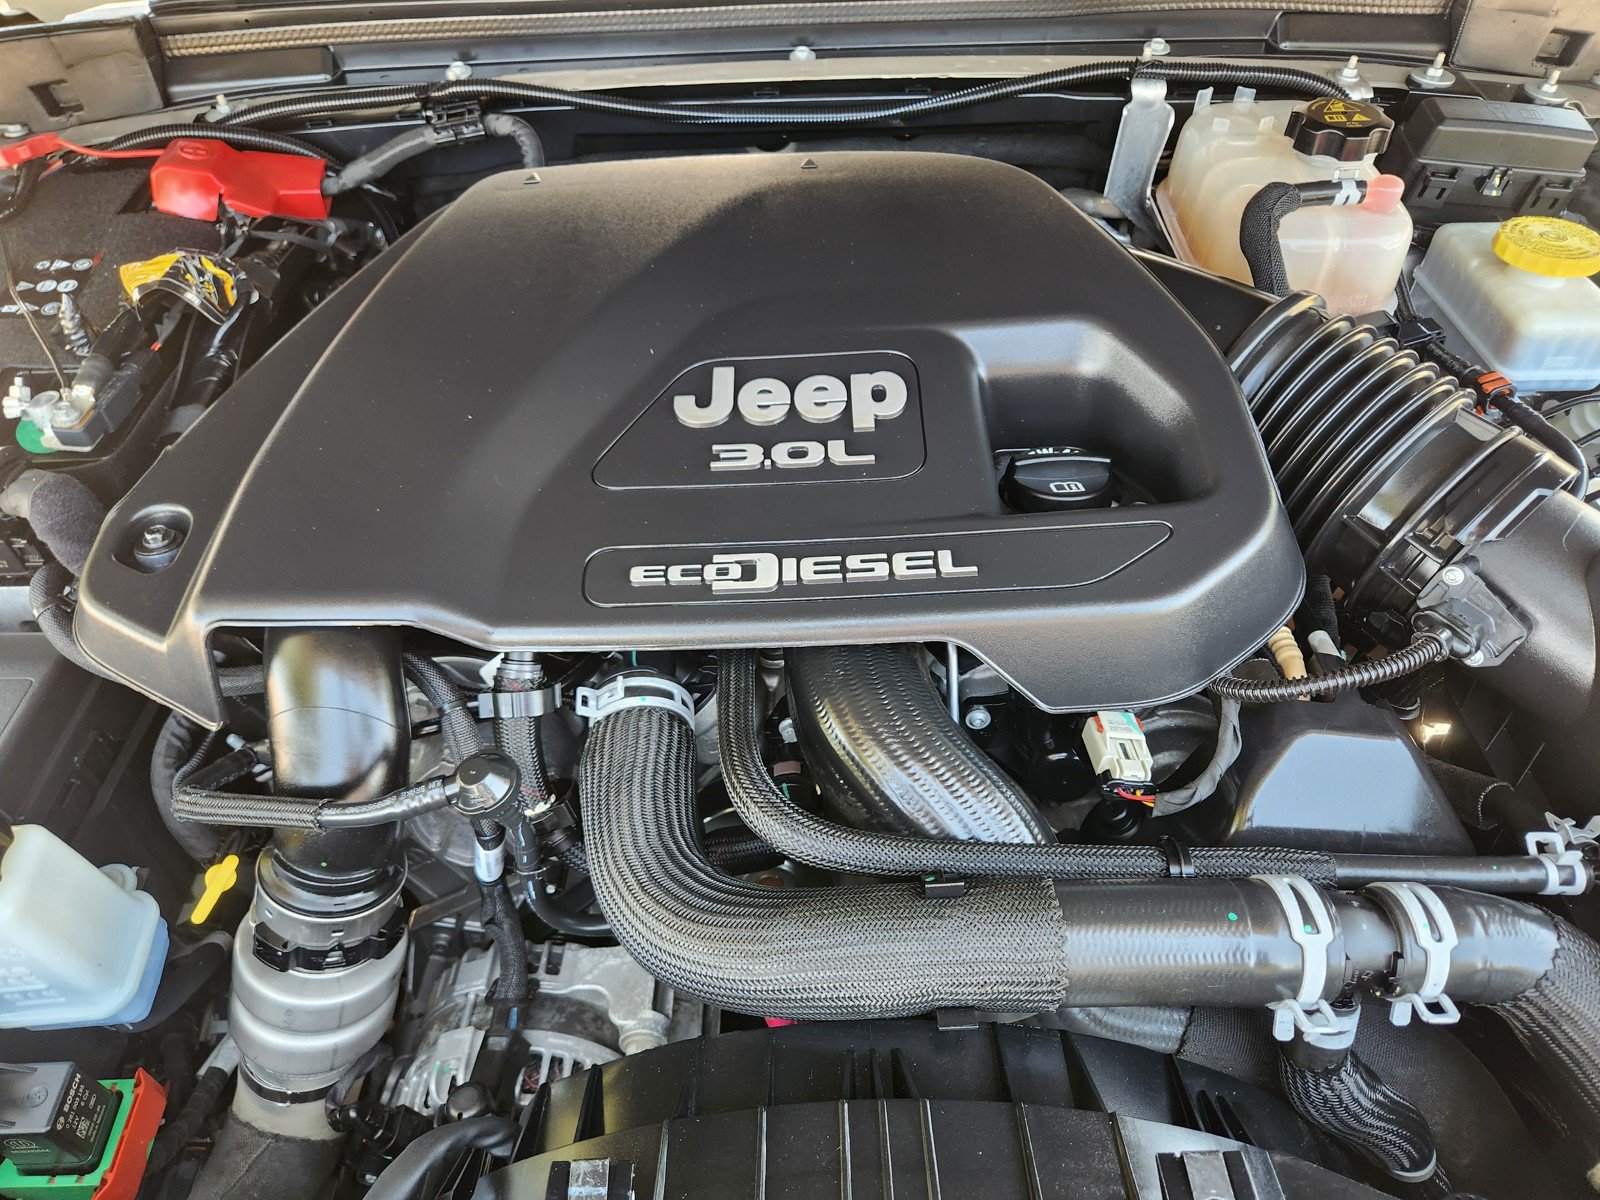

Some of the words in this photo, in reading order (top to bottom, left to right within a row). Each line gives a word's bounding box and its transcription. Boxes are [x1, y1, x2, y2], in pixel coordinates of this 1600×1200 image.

[673, 366, 908, 432] Jeep
[710, 440, 876, 471] 3.0L
[63, 1073, 81, 1112] BOSCH
